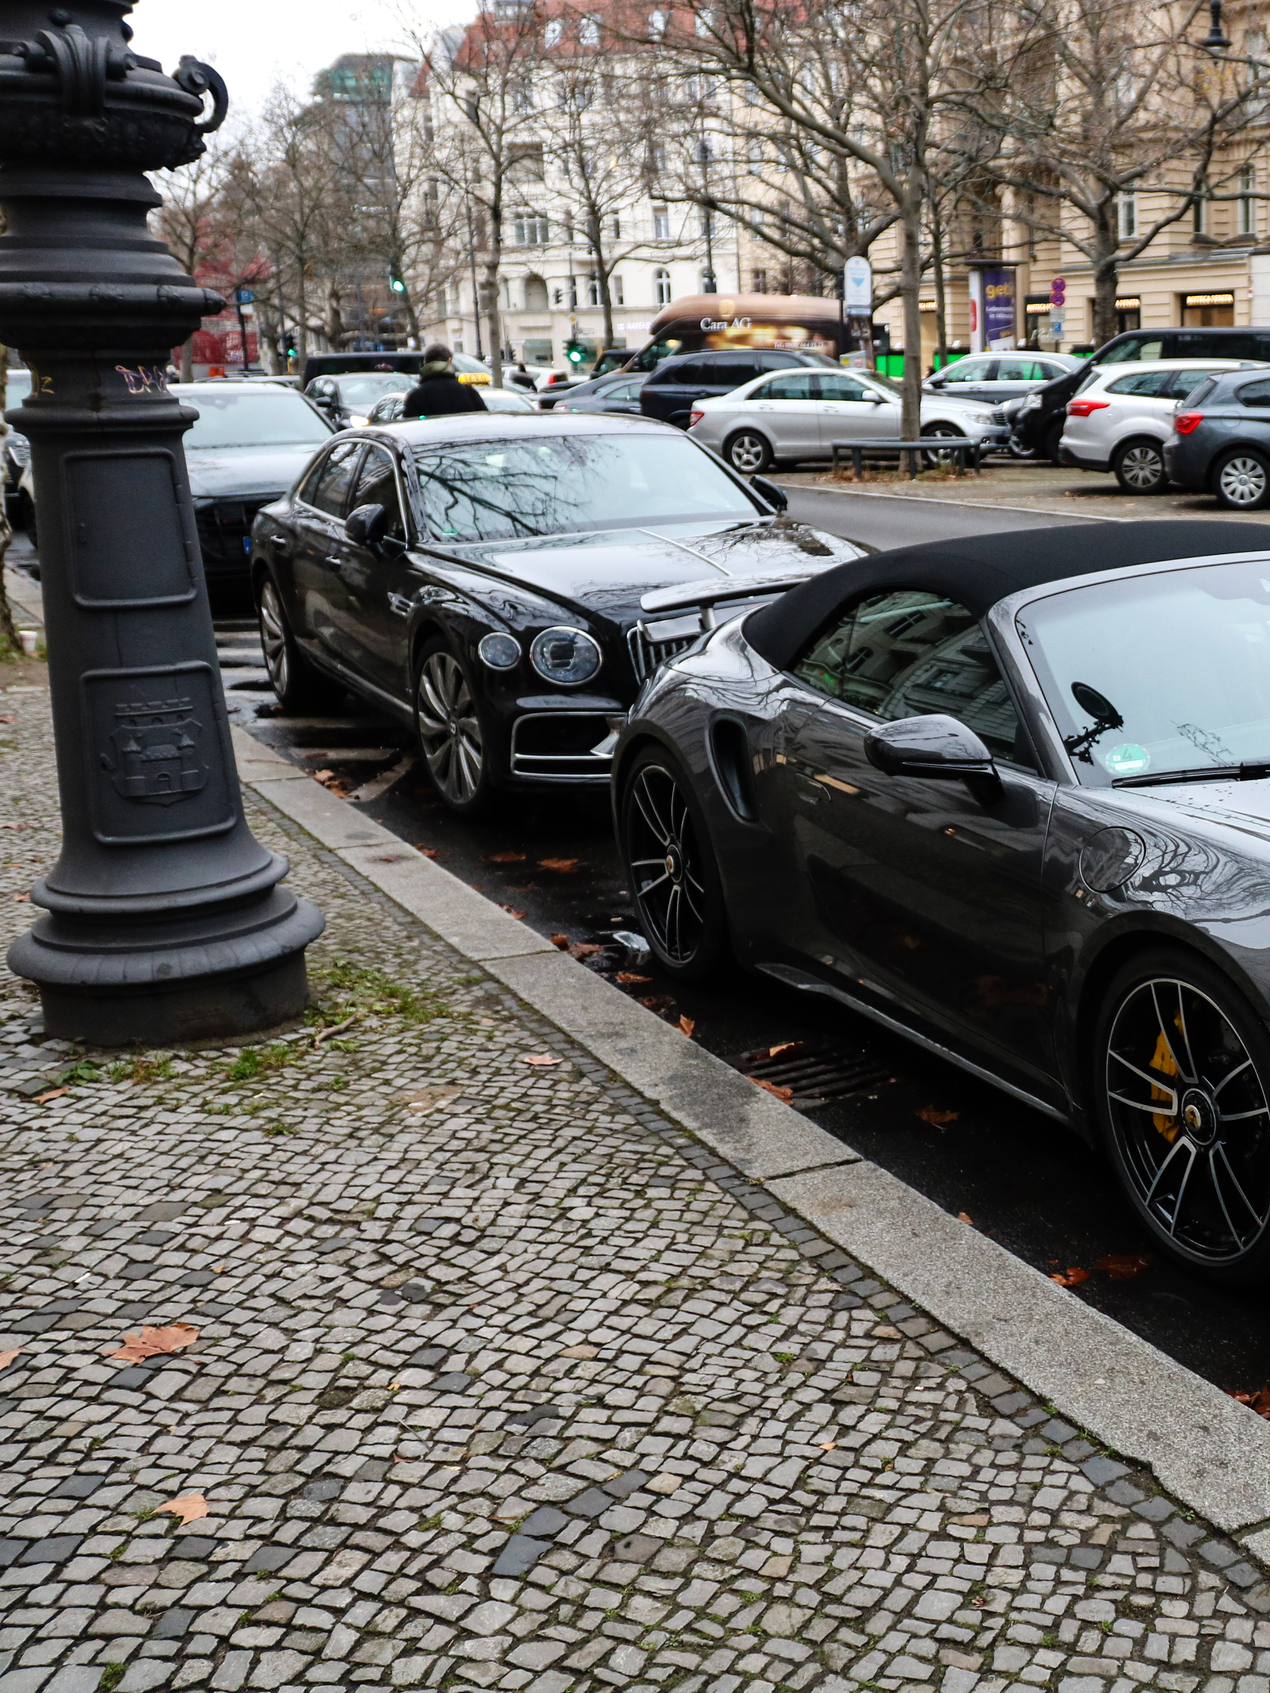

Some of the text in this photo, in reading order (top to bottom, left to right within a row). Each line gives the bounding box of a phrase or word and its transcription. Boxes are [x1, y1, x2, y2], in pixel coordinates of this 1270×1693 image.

[700, 317, 752, 332] Cara AG
[1122, 748, 1133, 760] 4
